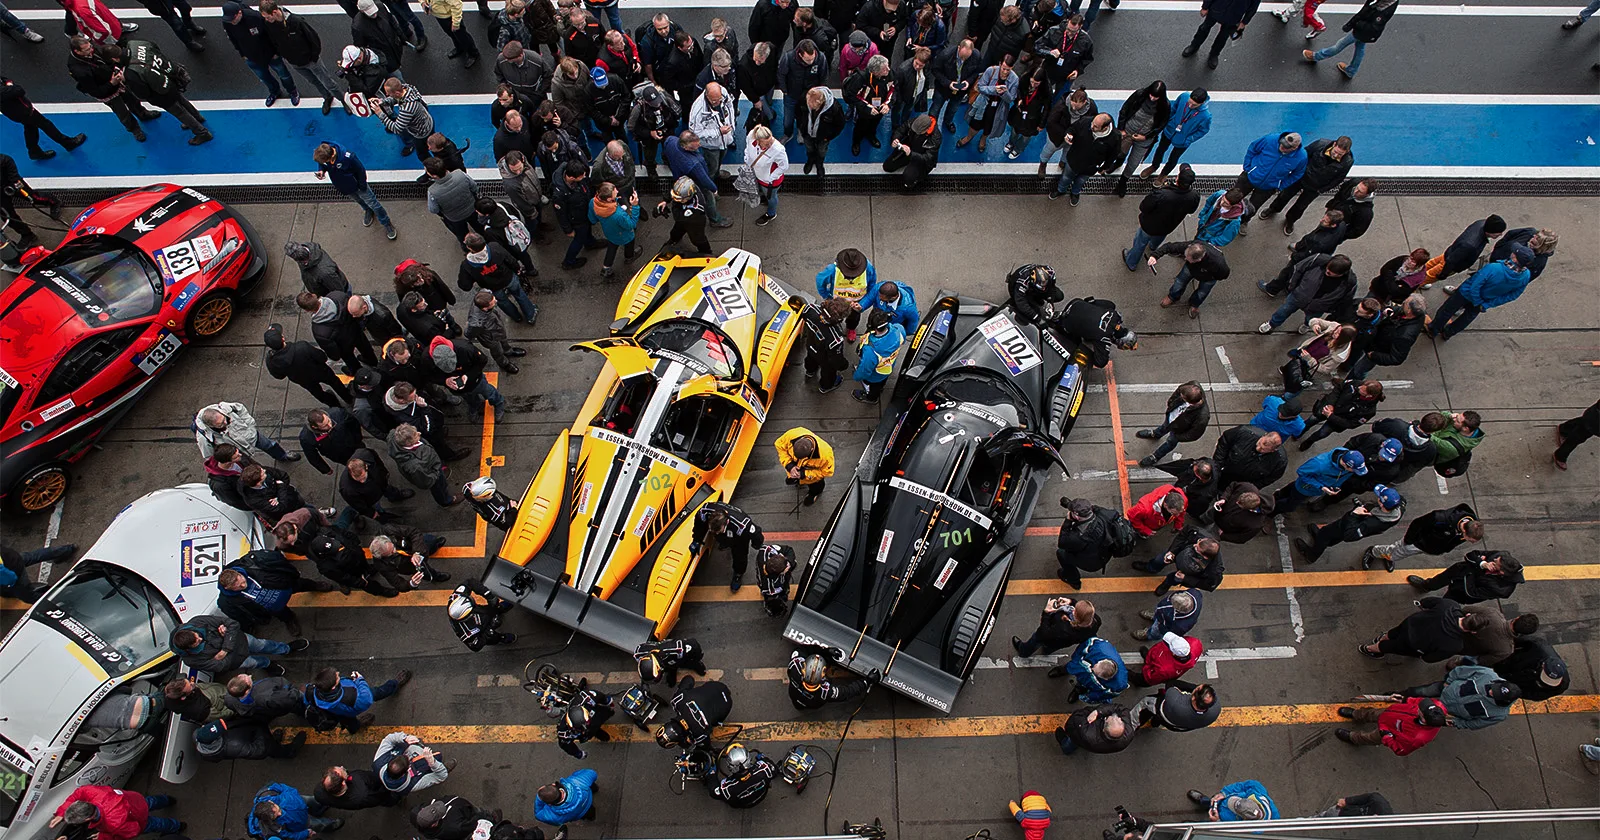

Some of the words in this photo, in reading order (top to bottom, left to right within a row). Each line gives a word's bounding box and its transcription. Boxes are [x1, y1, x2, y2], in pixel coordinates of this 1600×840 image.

[150, 54, 163, 76] 175
[350, 93, 370, 117] 8
[166, 247, 196, 276] 138
[715, 283, 747, 315] 702
[146, 340, 176, 367] 138
[655, 350, 688, 365] TURISMO
[1001, 335, 1034, 365] 701
[685, 360, 710, 374] GRAN
[958, 405, 988, 419] TURISMO
[986, 415, 1008, 428] GRAN
[638, 473, 673, 494] 702
[183, 523, 219, 535] ROWE
[940, 527, 972, 548] 701
[183, 546, 191, 573] premio
[194, 542, 220, 578] 521
[60, 618, 89, 639] TURISMO
[83, 635, 105, 651] GRAN
[87, 685, 110, 709] HOLVOET
[887, 677, 926, 700] Motorsport
[926, 695, 948, 710] Bosch
[64, 720, 80, 739] CLOSE
[0, 745, 26, 769] HOW.DE
